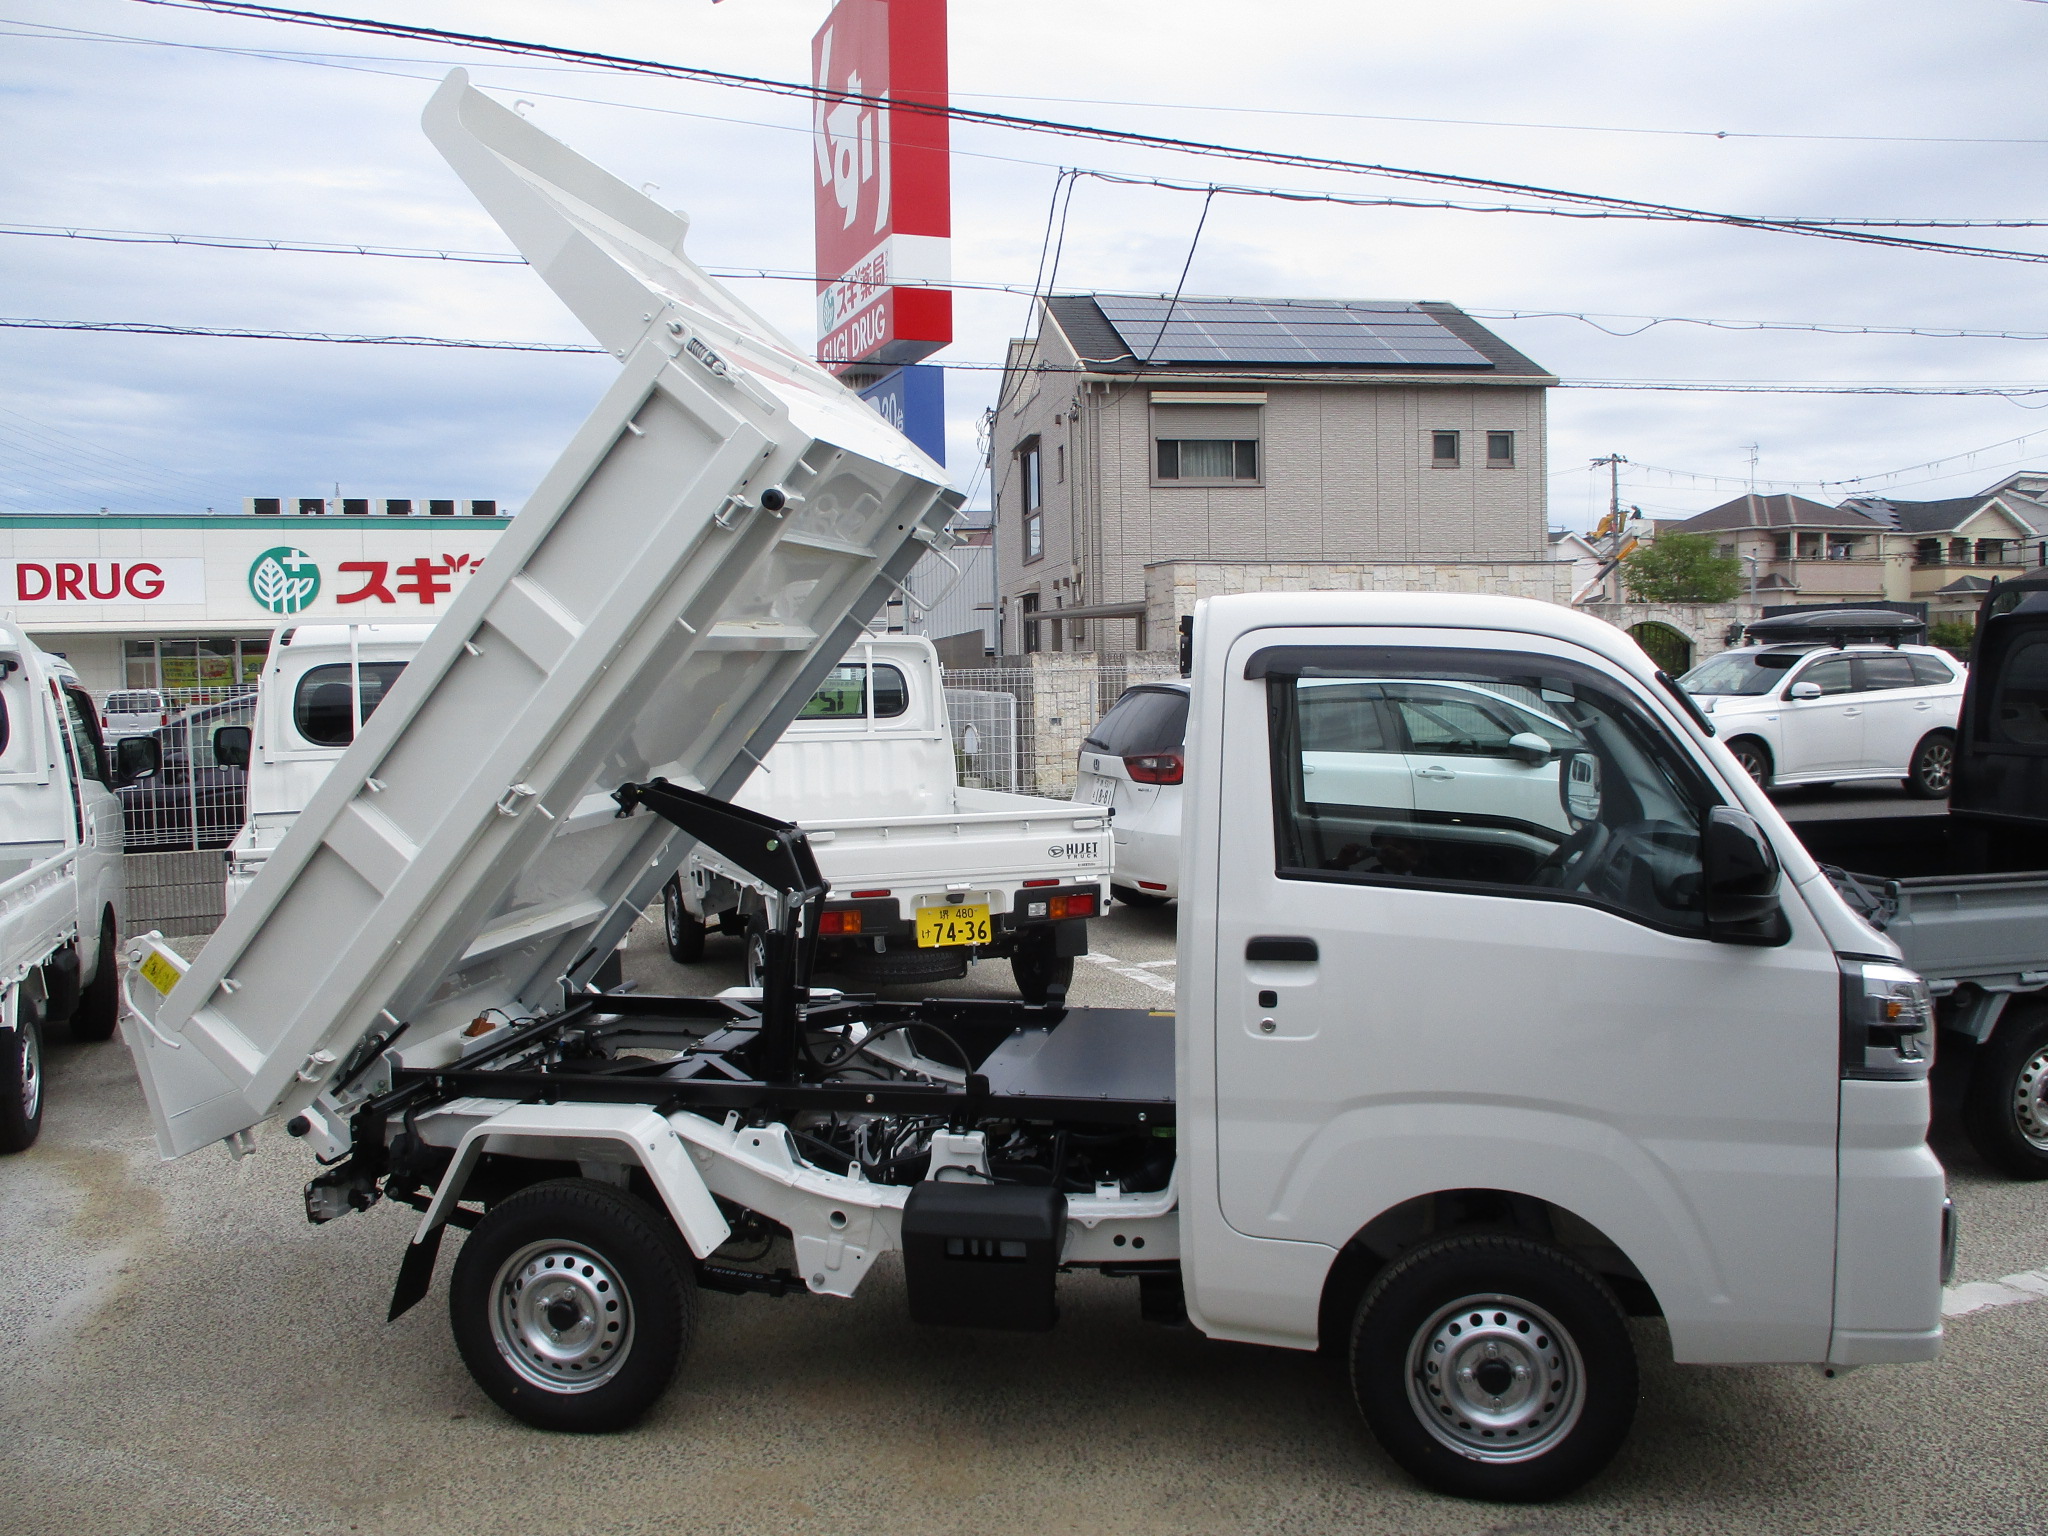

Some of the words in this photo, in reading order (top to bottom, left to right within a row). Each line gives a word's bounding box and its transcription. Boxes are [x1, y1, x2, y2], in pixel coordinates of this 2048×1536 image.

[813, 23, 890, 235] くすり
[836, 251, 885, 320] スギ薬局
[822, 328, 849, 373] SUGI
[852, 303, 886, 358] DRUG
[16, 562, 165, 601] DRUG
[336, 553, 486, 605] スギ
[1066, 841, 1098, 855] HIJET
[934, 920, 988, 943] 74-36
[939, 910, 950, 920] 堺
[955, 907, 974, 919] 480
